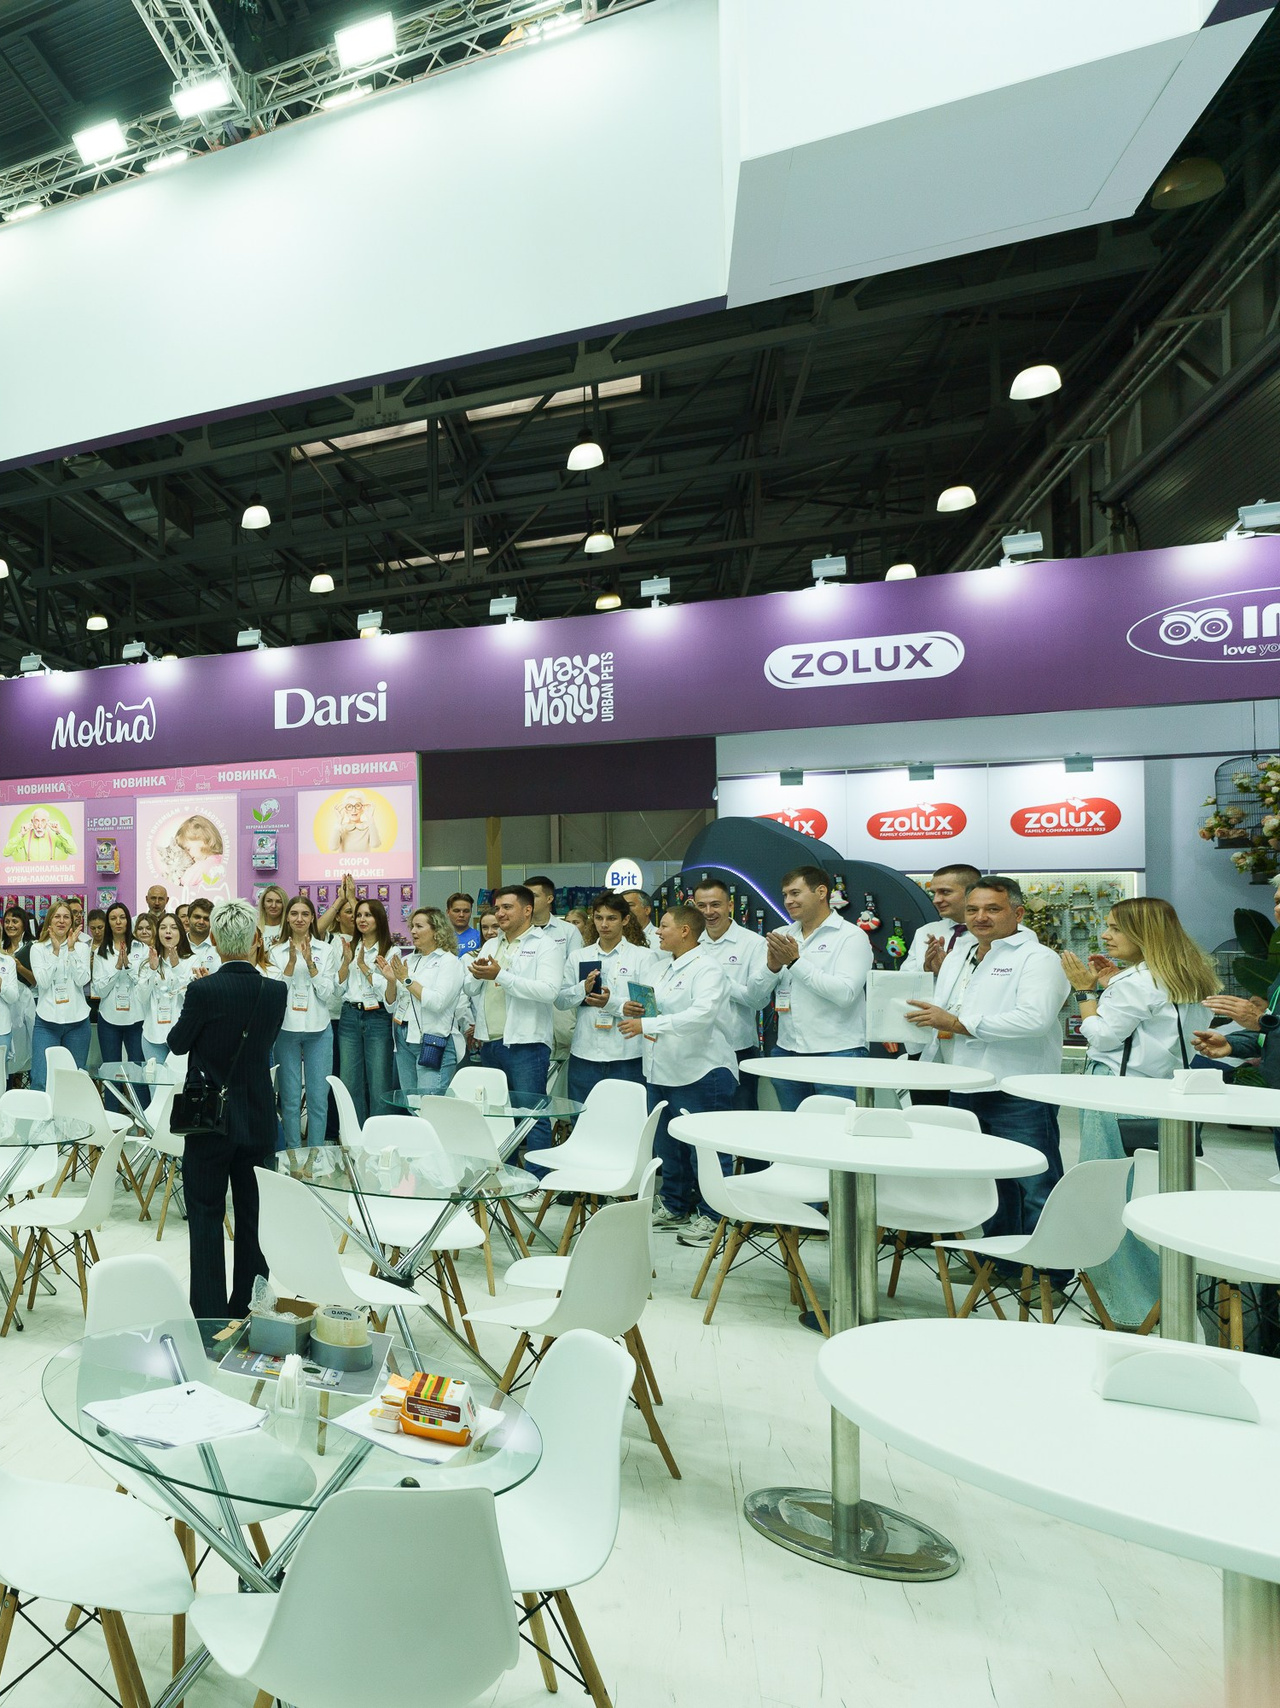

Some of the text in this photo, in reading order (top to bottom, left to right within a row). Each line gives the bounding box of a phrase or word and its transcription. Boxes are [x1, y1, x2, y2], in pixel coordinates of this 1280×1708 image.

[1223, 644, 1257, 656] love
[791, 642, 933, 679] ZOLUX
[524, 653, 600, 692] Max
[548, 681, 568, 698] &
[601, 652, 614, 722] URBAN PETS
[274, 681, 388, 730] Darsi
[524, 683, 600, 728] Molly
[51, 697, 156, 750] Molina
[218, 768, 277, 782] НОВИНКА
[334, 761, 399, 775] НОВИНКА
[17, 782, 66, 795] НОВИНКА
[113, 776, 166, 789] НОВИНКА
[879, 812, 953, 832] zolux
[1024, 807, 1106, 828] zolux
[339, 857, 370, 866] СКОРО
[5, 864, 75, 875] ФУНКЦИОНАЛЬНЫЕ
[325, 869, 331, 877] В
[7, 874, 75, 884] КРЕМ-ЛАКОМСТВА
[611, 871, 637, 886] Brit
